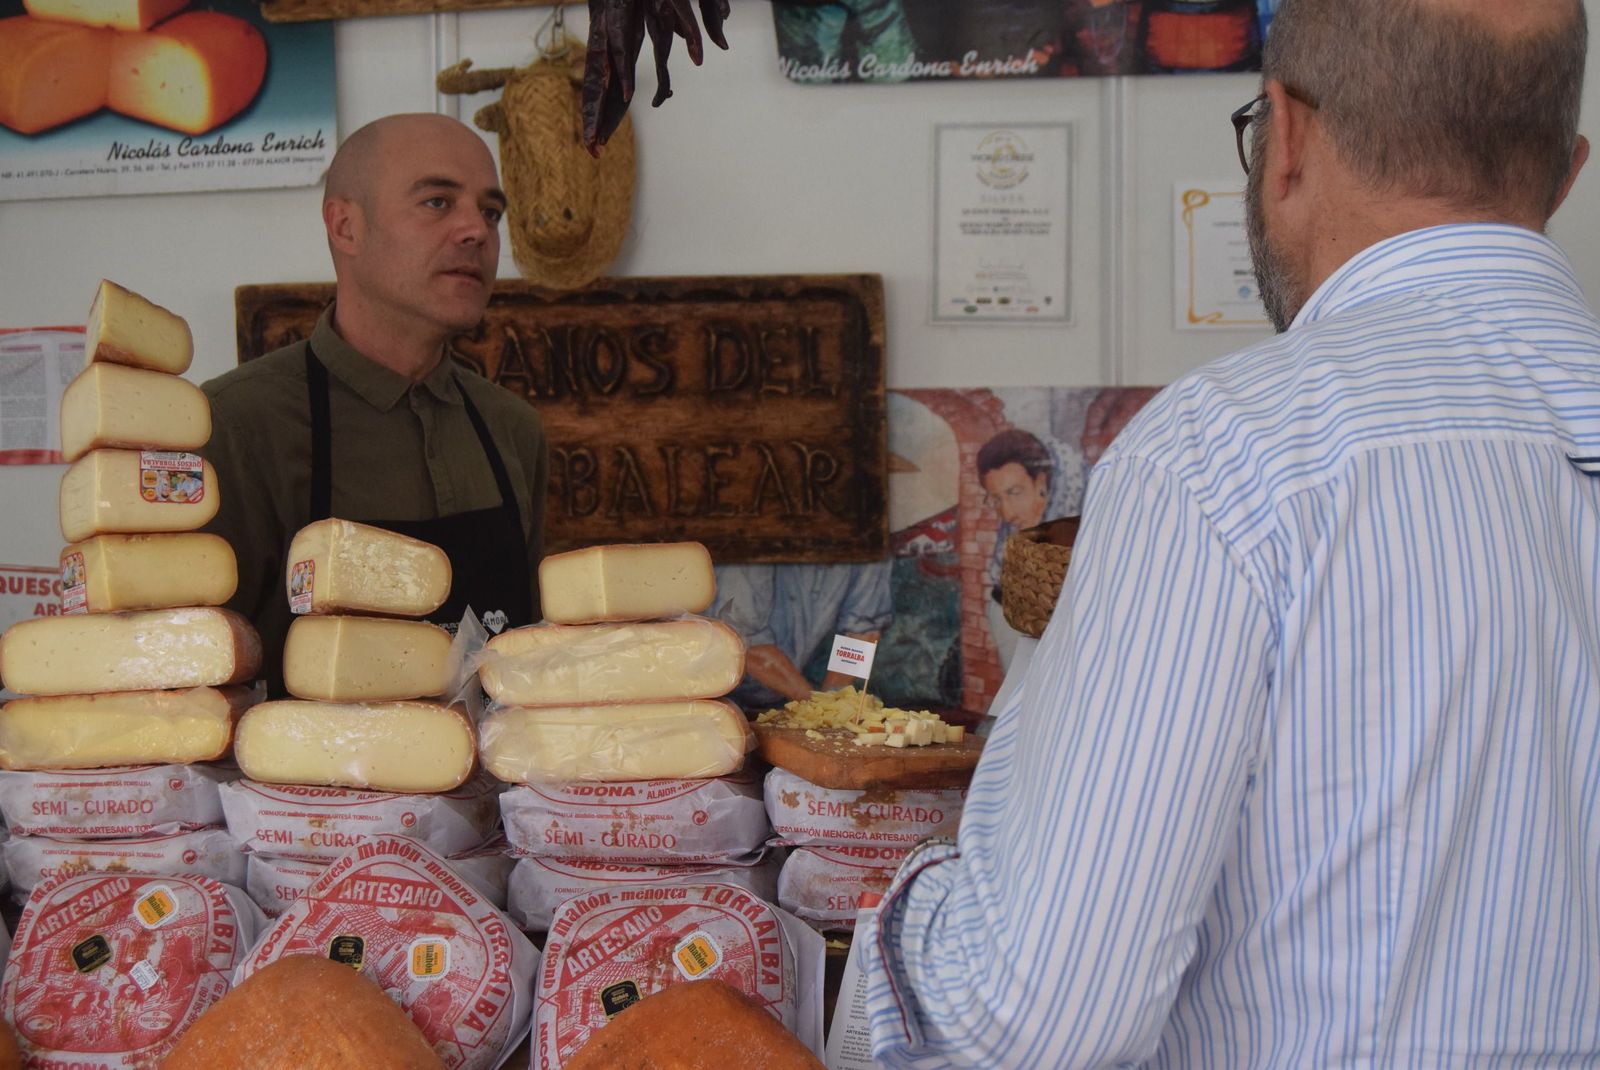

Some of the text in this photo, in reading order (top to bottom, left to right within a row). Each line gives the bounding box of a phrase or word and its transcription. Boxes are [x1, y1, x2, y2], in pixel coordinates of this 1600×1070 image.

[857, 51, 953, 79] Cardona
[960, 49, 1039, 76] Enrich
[107, 128, 326, 161] Nicolás Cardona Enrich
[706, 322, 840, 397] DEL
[553, 439, 843, 519] BALEAR
[836, 649, 865, 662] TORRALBA
[646, 785, 677, 800] ALAIOR
[31, 801, 68, 816] SEMI
[84, 800, 154, 815] CURADO
[353, 814, 383, 822] TORRALBA
[807, 800, 848, 817] SEMI
[866, 804, 944, 824] CURADO
[49, 826, 88, 835] MENORCA
[90, 824, 133, 834] ARTESANO
[255, 829, 293, 845] SEMI
[544, 829, 584, 846] SEMI
[601, 832, 676, 849] CURADO
[822, 829, 868, 840] MENORCA
[870, 832, 920, 842] ARTESANO
[338, 878, 443, 908] ARTESANO
[34, 877, 131, 940] ARTESANO
[315, 855, 354, 892] queso
[463, 911, 510, 1033] TORRALBA
[543, 942, 562, 989] queso
[702, 885, 780, 985] TORRALBA
[566, 905, 663, 978] ARTESANO
